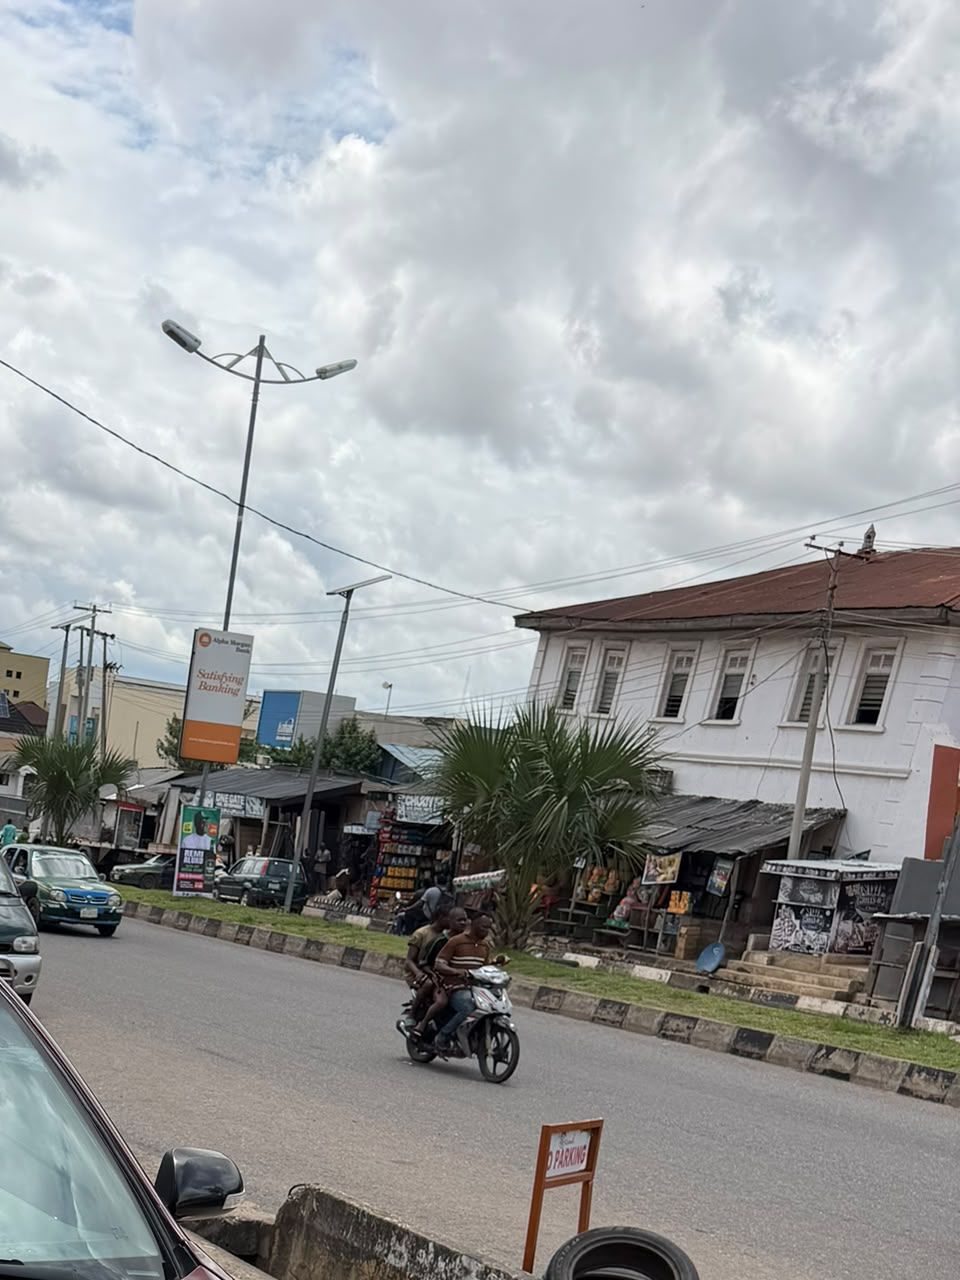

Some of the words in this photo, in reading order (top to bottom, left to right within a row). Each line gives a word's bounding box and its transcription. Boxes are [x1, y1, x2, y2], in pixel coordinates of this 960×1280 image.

[197, 668, 245, 686] Satisfying
[198, 681, 241, 697] Banking
[553, 1144, 587, 1170] PARKING
